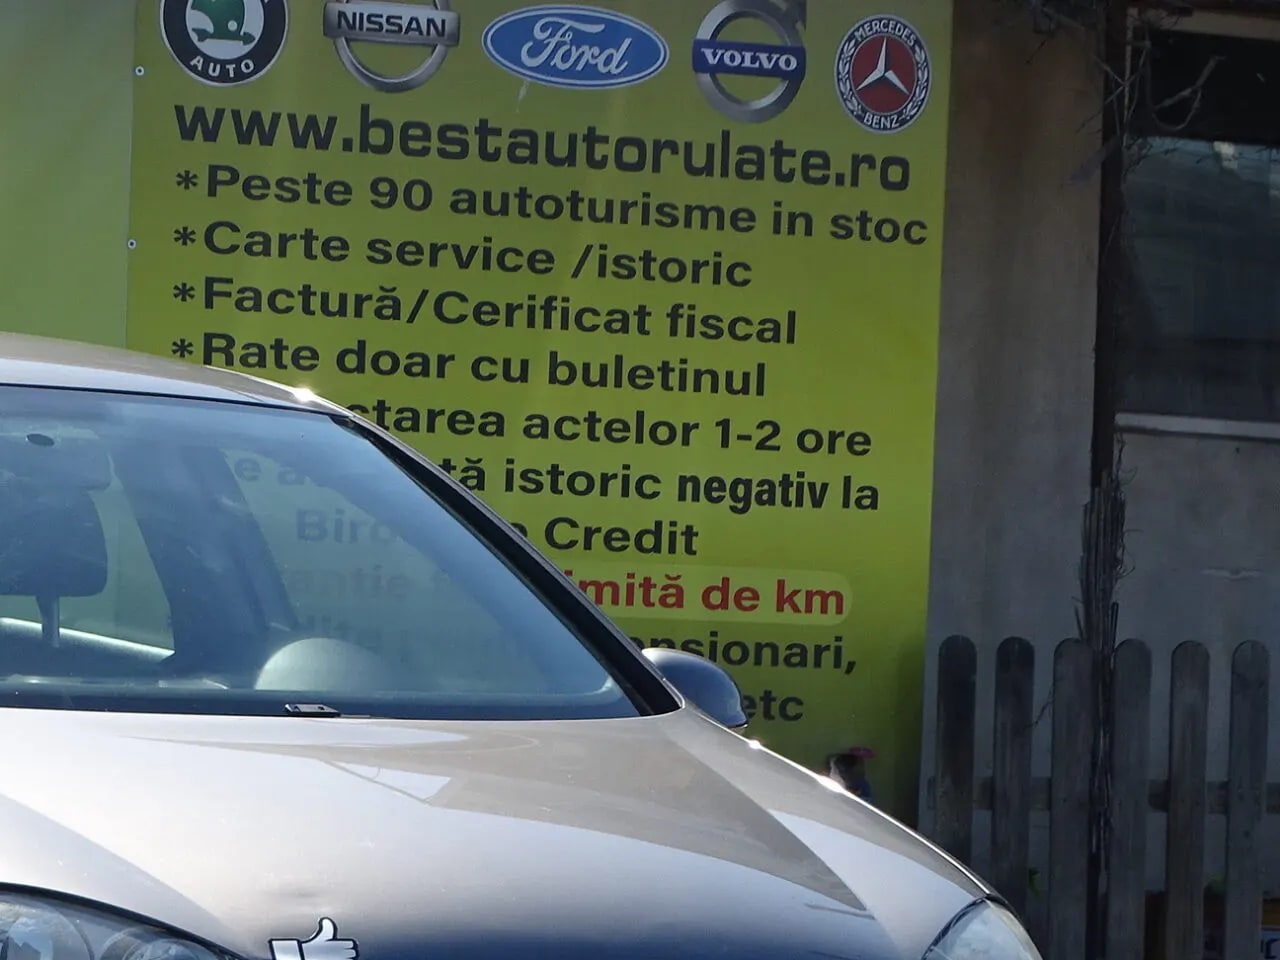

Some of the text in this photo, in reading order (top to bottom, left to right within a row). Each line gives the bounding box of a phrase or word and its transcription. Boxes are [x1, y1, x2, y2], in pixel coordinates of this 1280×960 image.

[336, 10, 447, 38] NISSAN
[521, 16, 632, 75] Ford
[855, 18, 917, 46] MERCEDES
[189, 55, 255, 79] AUTO
[701, 47, 798, 71] VOLVO
[863, 112, 900, 129] BENZ
[174, 103, 910, 191] www.bestautorulate.ro
[370, 176, 433, 212] 90
[450, 186, 757, 233] autoturisme
[772, 201, 814, 237] in
[829, 210, 928, 245] stoc
[365, 237, 555, 274] service
[570, 244, 753, 287] /istoric
[666, 303, 796, 345] fiscal
[336, 340, 455, 379] doar
[470, 354, 529, 384] cu
[548, 350, 766, 397] buletinul
[523, 410, 700, 447] actelor
[715, 418, 781, 452] 1-2
[797, 428, 872, 456] ore
[505, 458, 662, 500] istoric
[677, 471, 829, 515] negativ
[842, 475, 879, 511] la
[544, 517, 699, 556] Credit
[564, 570, 845, 616] mită de km
